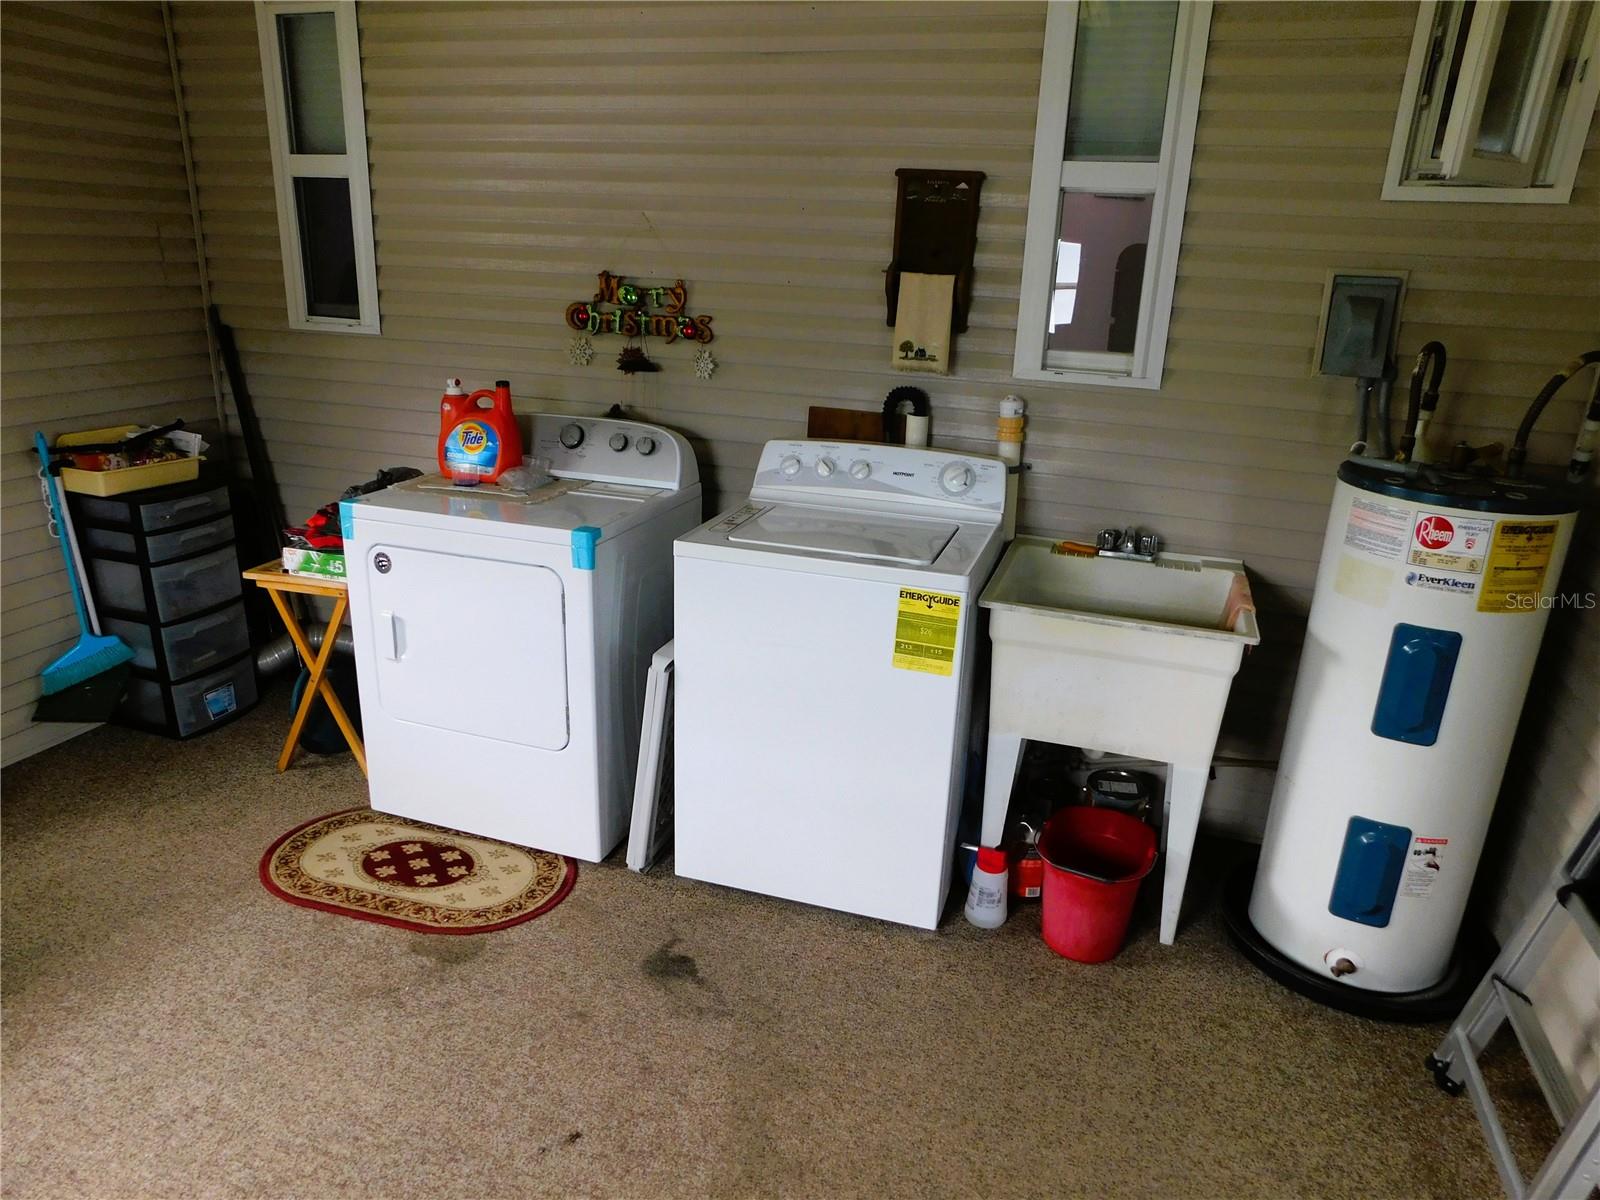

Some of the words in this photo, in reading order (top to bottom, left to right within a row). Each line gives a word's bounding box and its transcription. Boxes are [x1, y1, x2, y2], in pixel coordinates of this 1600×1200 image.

[462, 430, 483, 446] Tide
[1418, 517, 1453, 545] Rheem
[1418, 573, 1476, 590] EverKleen
[899, 590, 960, 607] ENERGYGUIDE
